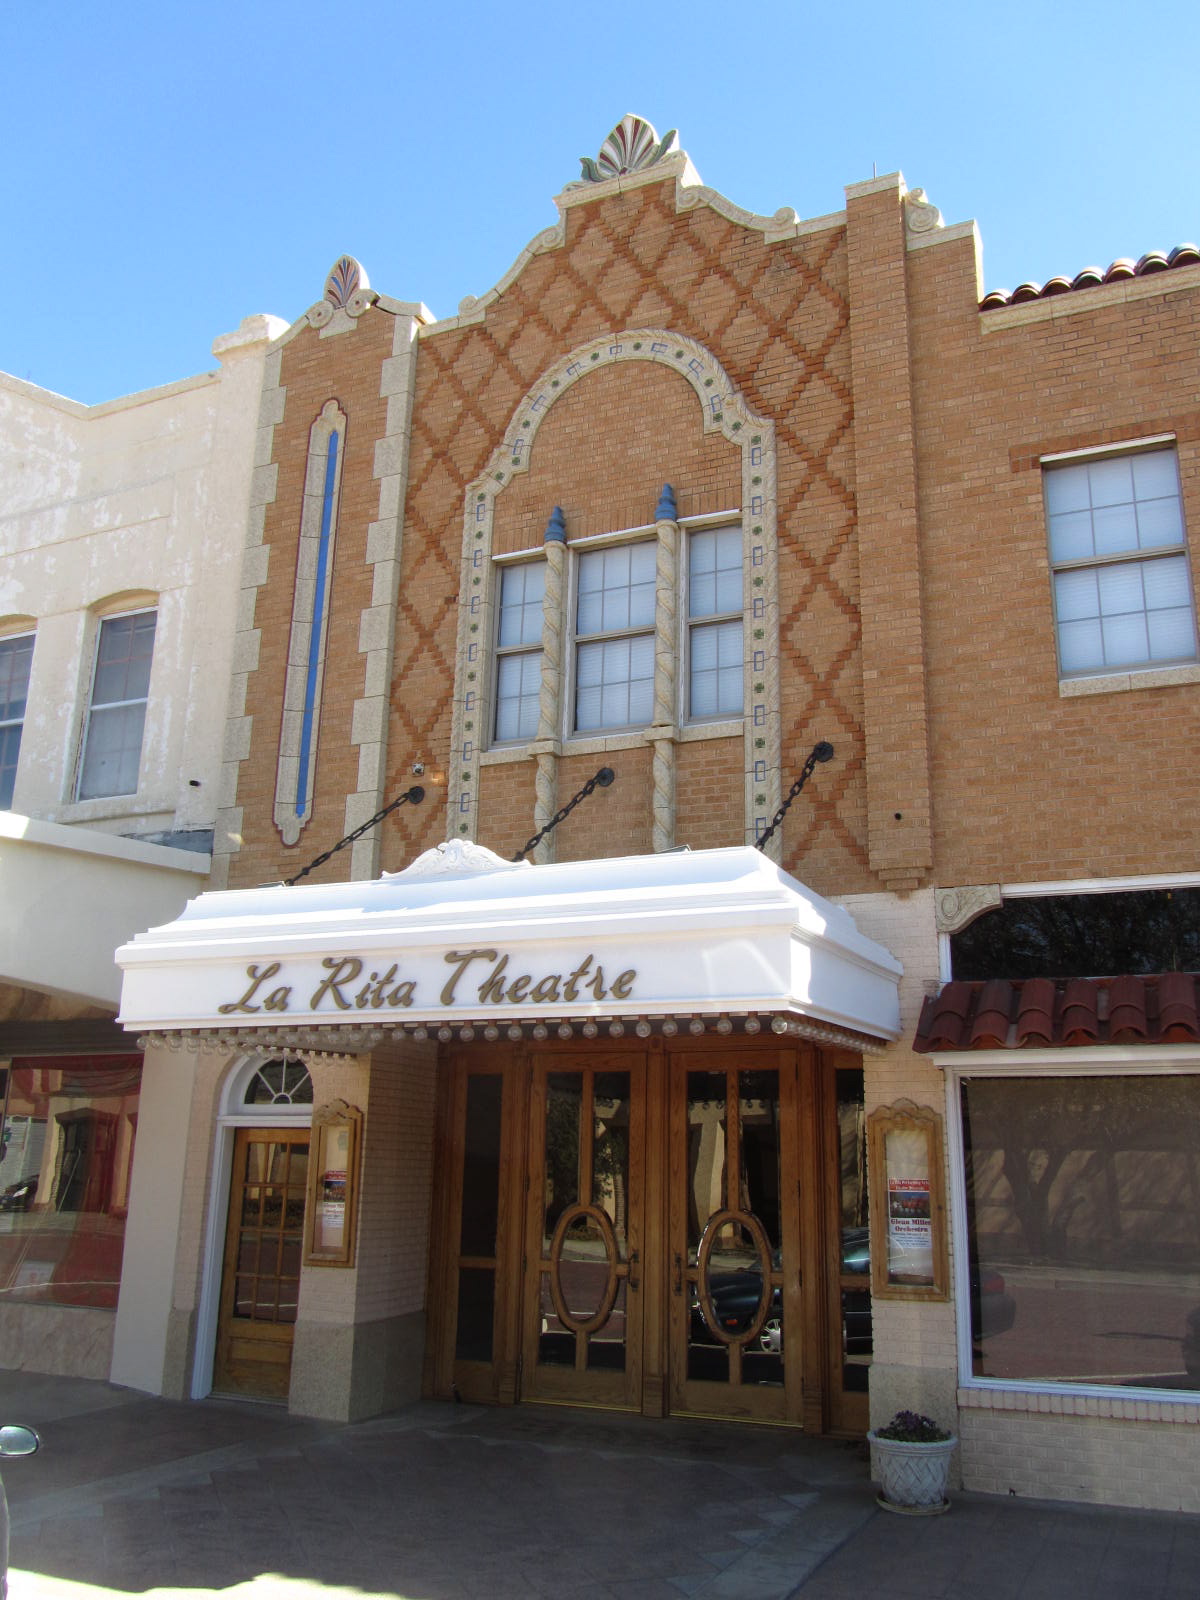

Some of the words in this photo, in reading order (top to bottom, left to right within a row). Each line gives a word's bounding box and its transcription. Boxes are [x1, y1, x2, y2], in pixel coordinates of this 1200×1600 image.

[218, 962, 293, 1015] La
[309, 956, 418, 1011] Rita
[439, 948, 639, 1006] Theatre
